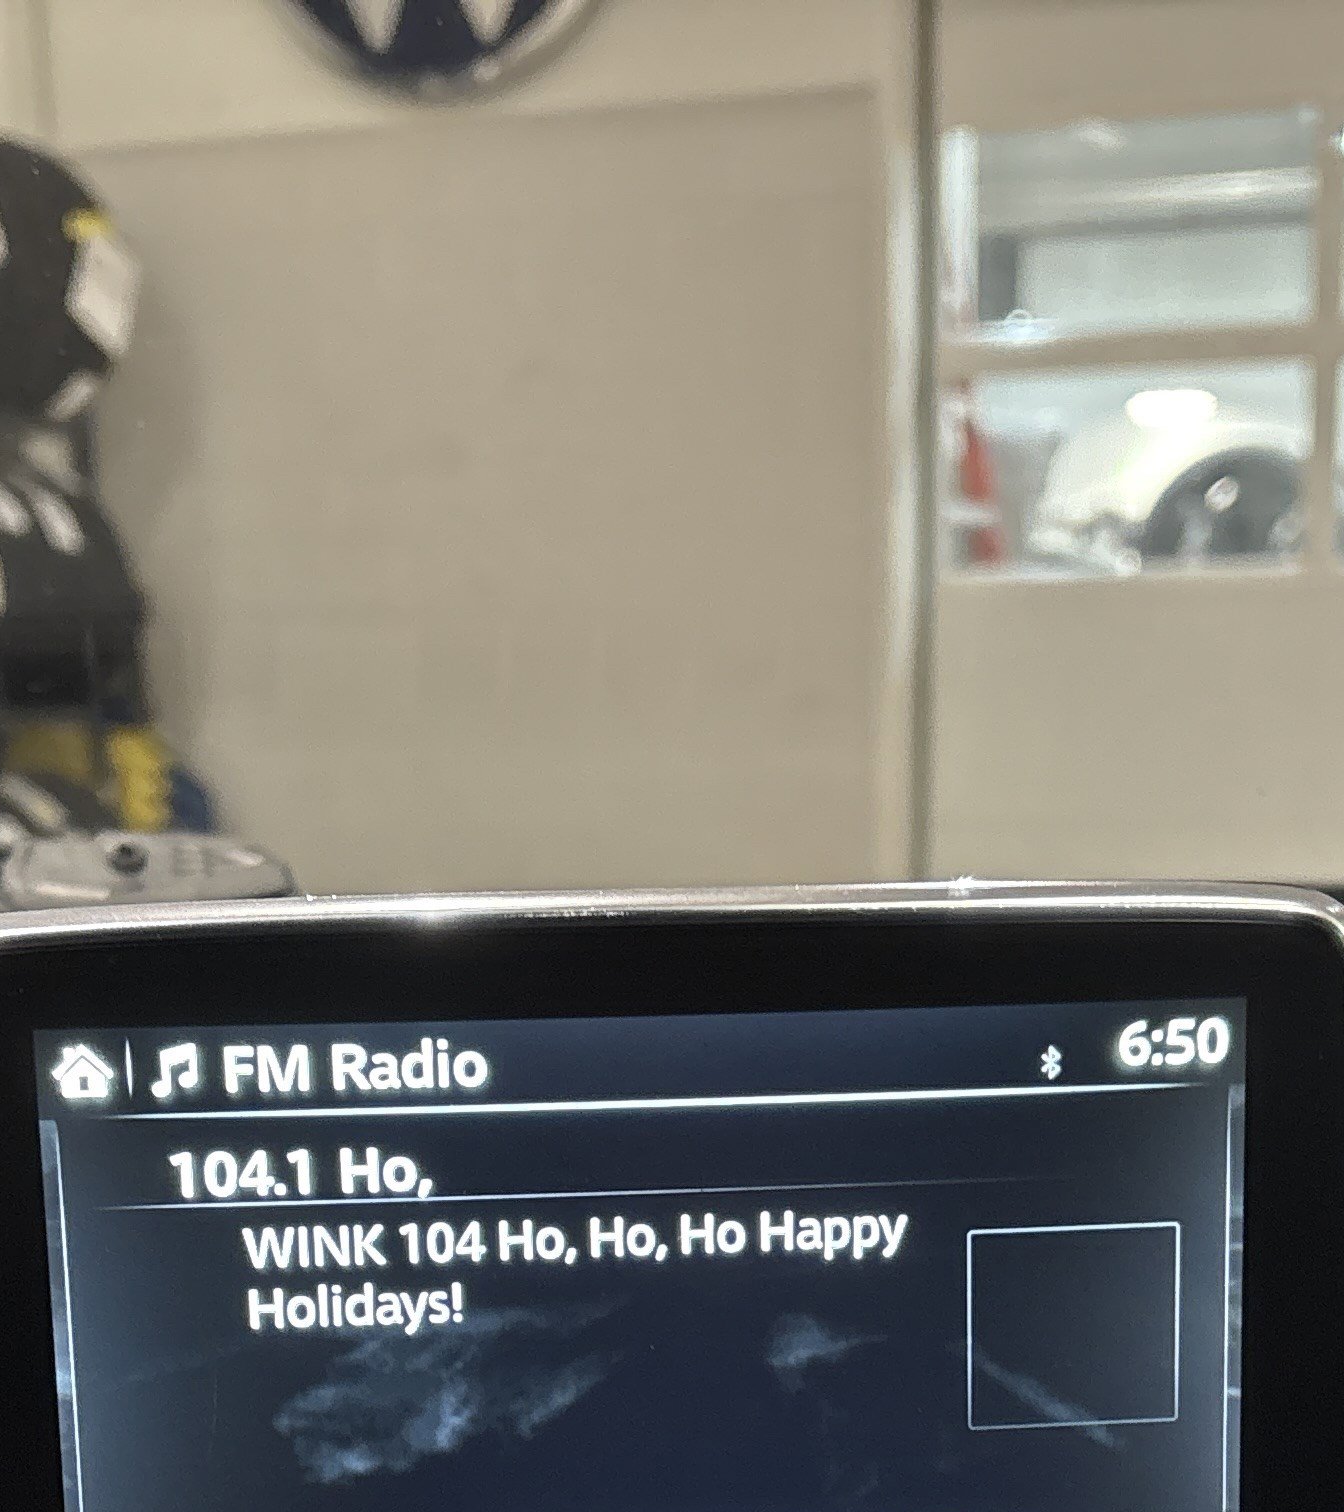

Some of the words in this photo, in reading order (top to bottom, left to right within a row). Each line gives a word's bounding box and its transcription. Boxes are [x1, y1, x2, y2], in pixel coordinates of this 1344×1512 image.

[221, 1041, 313, 1097] FM
[330, 1036, 490, 1094] Radio
[1117, 1015, 1231, 1068] 6:50
[167, 1148, 314, 1200] 104.1
[338, 1146, 435, 1200] Ho,
[240, 1223, 389, 1271] WINK
[397, 1219, 489, 1266] 104
[497, 1218, 579, 1266] Ho,
[588, 1215, 670, 1263] Ho,
[679, 1212, 748, 1257] Ho
[758, 1209, 910, 1262] Happy
[246, 1281, 466, 1336] Holidays!
